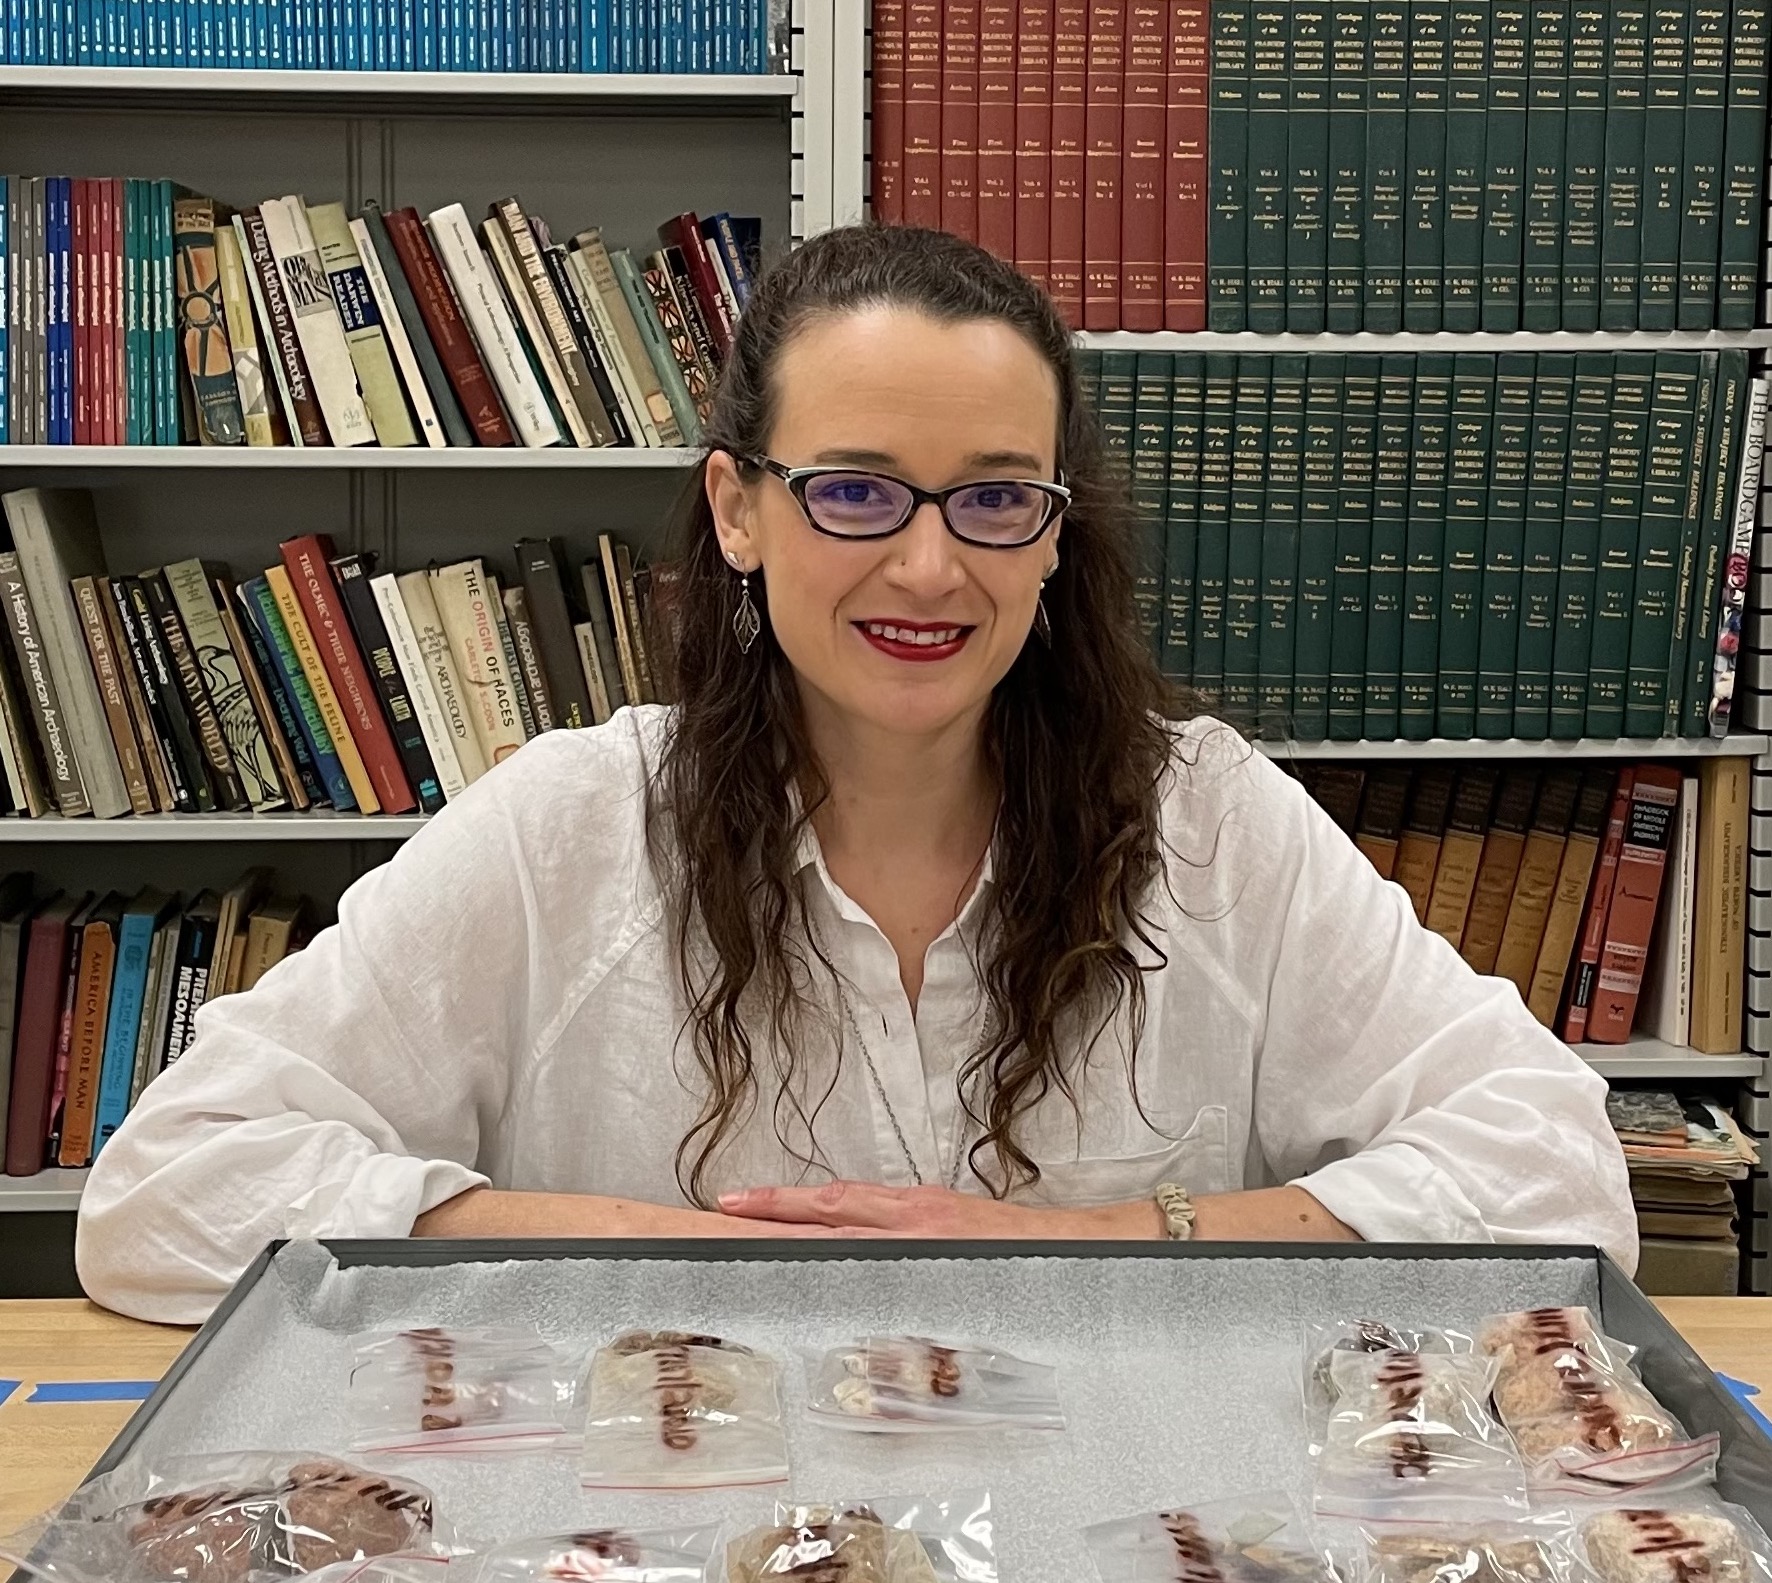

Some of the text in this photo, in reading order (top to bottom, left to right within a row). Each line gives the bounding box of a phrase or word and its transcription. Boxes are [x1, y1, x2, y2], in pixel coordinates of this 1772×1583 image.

[332, 275, 353, 328] READER
[343, 272, 364, 324] DARWIN
[355, 277, 369, 303] THE
[502, 201, 576, 356] MAN AND THE ENVIRONMENT
[250, 221, 306, 400] Dating Methods in Archaeology
[572, 309, 581, 322] ART
[593, 327, 601, 342] Age
[675, 275, 716, 381] Kinesics and Contex
[1699, 378, 1709, 409] INDEX
[1751, 388, 1769, 428] THE
[1693, 425, 1705, 466] SUBJECT
[1713, 379, 1735, 520] INDEX to SUBJECT HEADINGS
[1688, 469, 1699, 519] HEADINGS
[1735, 434, 1763, 551] BOARDGAME
[1675, 545, 1692, 639] Peabody Museum Library
[1698, 544, 1717, 638] Peabody Museum Library
[79, 587, 120, 705] QUEST FOR THE PAST
[140, 613, 153, 639] Living
[298, 552, 314, 577] THE
[308, 578, 329, 617] OLMEC
[327, 628, 346, 664] THEIR
[340, 665, 372, 729] NEIGHBORS
[463, 567, 514, 726] THE ORIGIN OF RACES
[498, 622, 512, 643] THE
[7, 581, 69, 780] A History of American Archaeology
[136, 658, 148, 674] and
[281, 592, 345, 741] THE CULT OF THE FELINE
[503, 643, 518, 669] FIRST
[515, 621, 545, 703] in archeology
[582, 634, 598, 684] ARCHAEOLOGY
[160, 610, 186, 652] THE
[175, 653, 202, 701] MAYA
[195, 700, 229, 768] WORLD
[372, 647, 411, 721] PEOPLE EARTH
[437, 665, 466, 738] ARCHAEOLOGY
[1719, 822, 1731, 953] ETHNOGRAPHIC BIBLIOGRAPHY
[1733, 844, 1741, 881] AMERICA
[1732, 886, 1740, 915] NORTH
[86, 950, 102, 1015] AMERICA
[122, 1002, 132, 1024] THE
[79, 1020, 94, 1072] BEFORE
[75, 1078, 87, 1109] MAN
